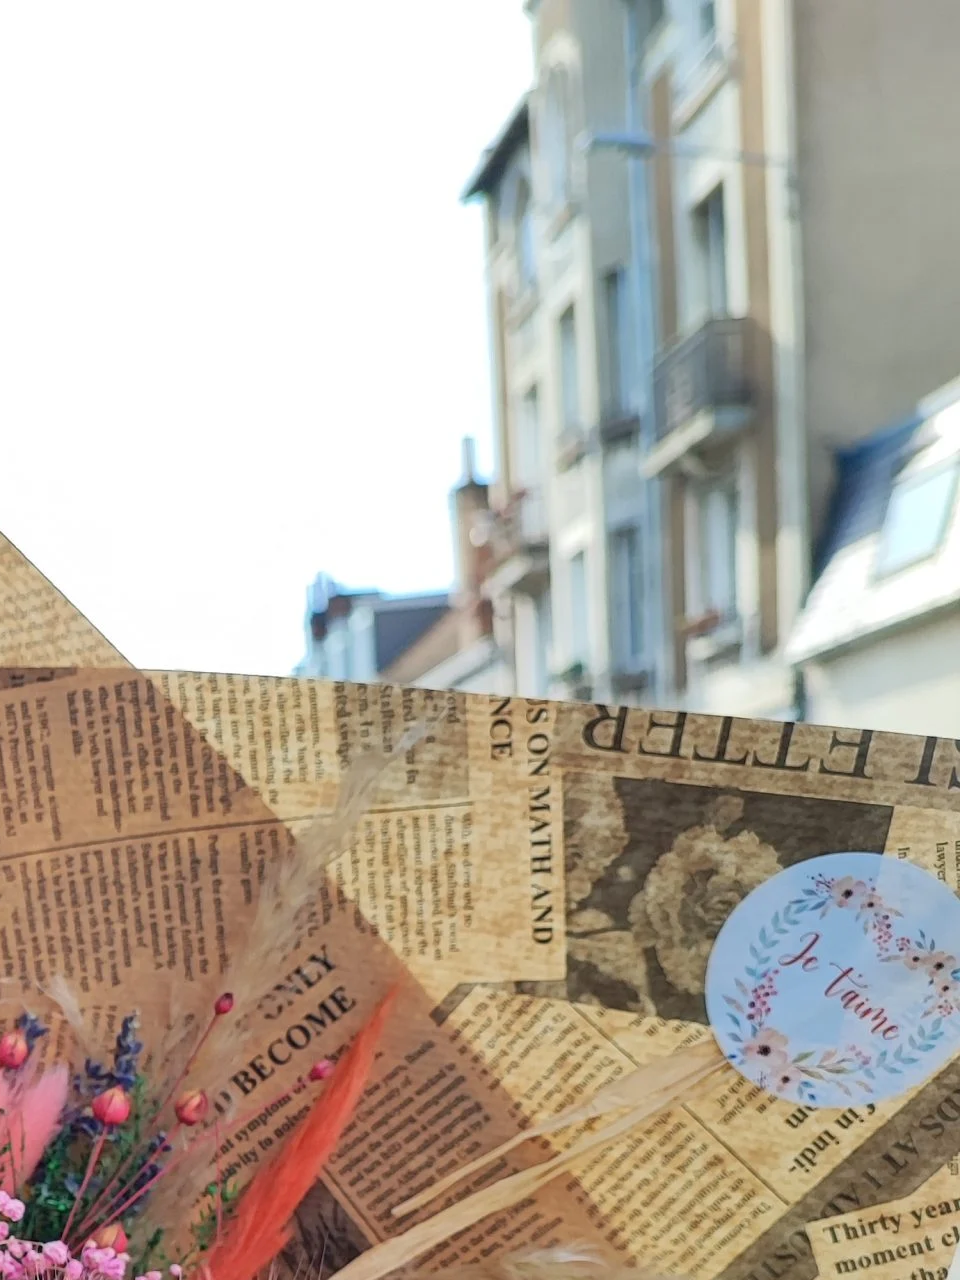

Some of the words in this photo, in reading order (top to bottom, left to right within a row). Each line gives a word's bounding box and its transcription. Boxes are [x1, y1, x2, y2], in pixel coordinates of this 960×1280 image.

[528, 734, 550, 776] ON
[529, 786, 552, 873] MATH
[532, 885, 552, 944] AND
[257, 944, 336, 1019] ONLY
[231, 987, 356, 1095] BECOME
[235, 1094, 291, 1141] symptom
[256, 1132, 274, 1150] to
[274, 1106, 311, 1139] noises
[790, 1130, 839, 1172] indi-
[823, 1214, 901, 1243] Thirty
[835, 1236, 934, 1274] moment
